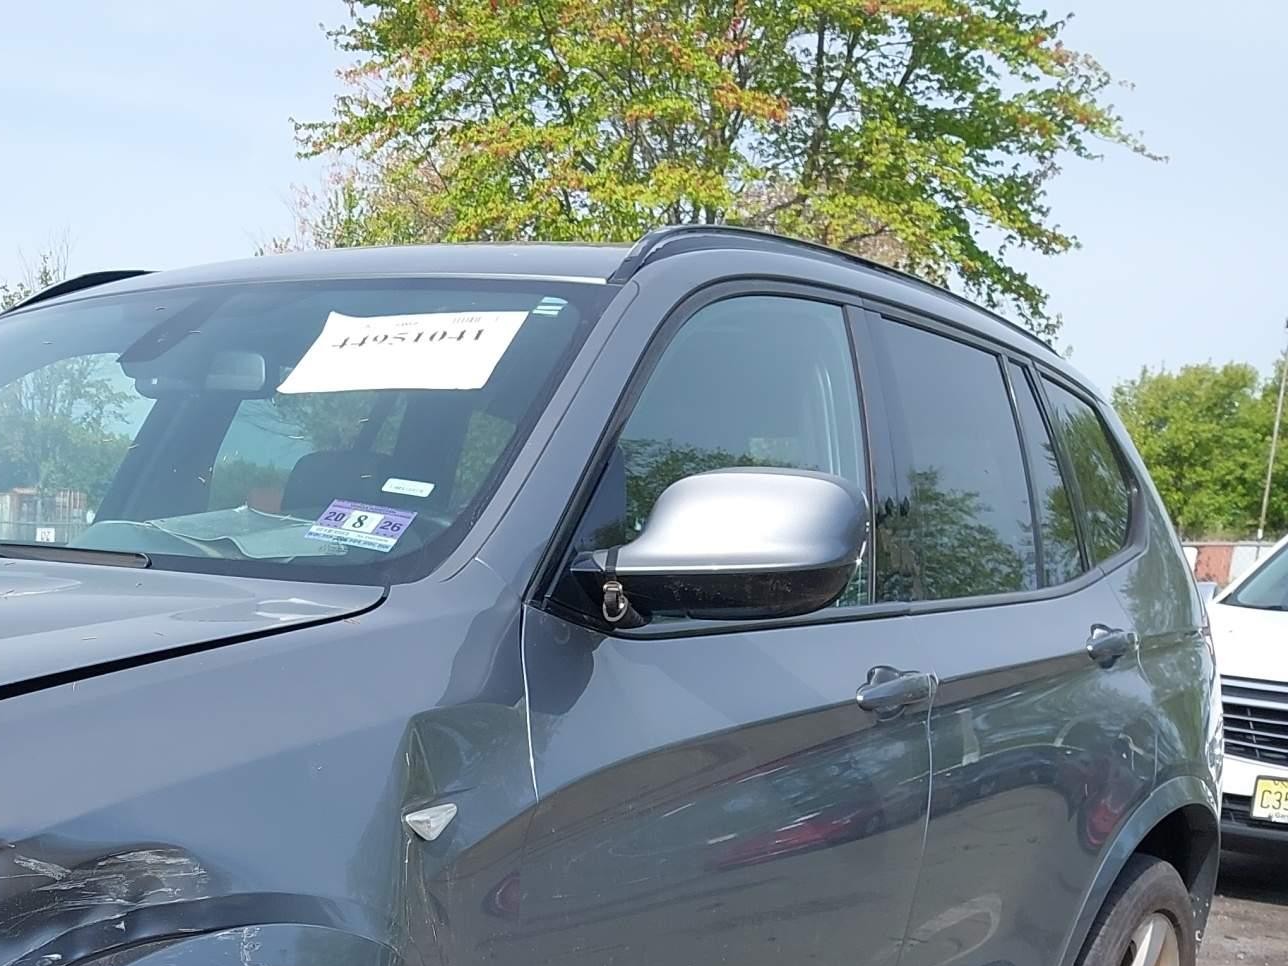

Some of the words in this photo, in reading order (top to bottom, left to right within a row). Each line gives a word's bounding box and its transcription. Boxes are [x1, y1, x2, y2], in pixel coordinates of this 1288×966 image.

[324, 511, 347, 522] 20
[352, 514, 369, 528] 8
[379, 520, 403, 532] 26
